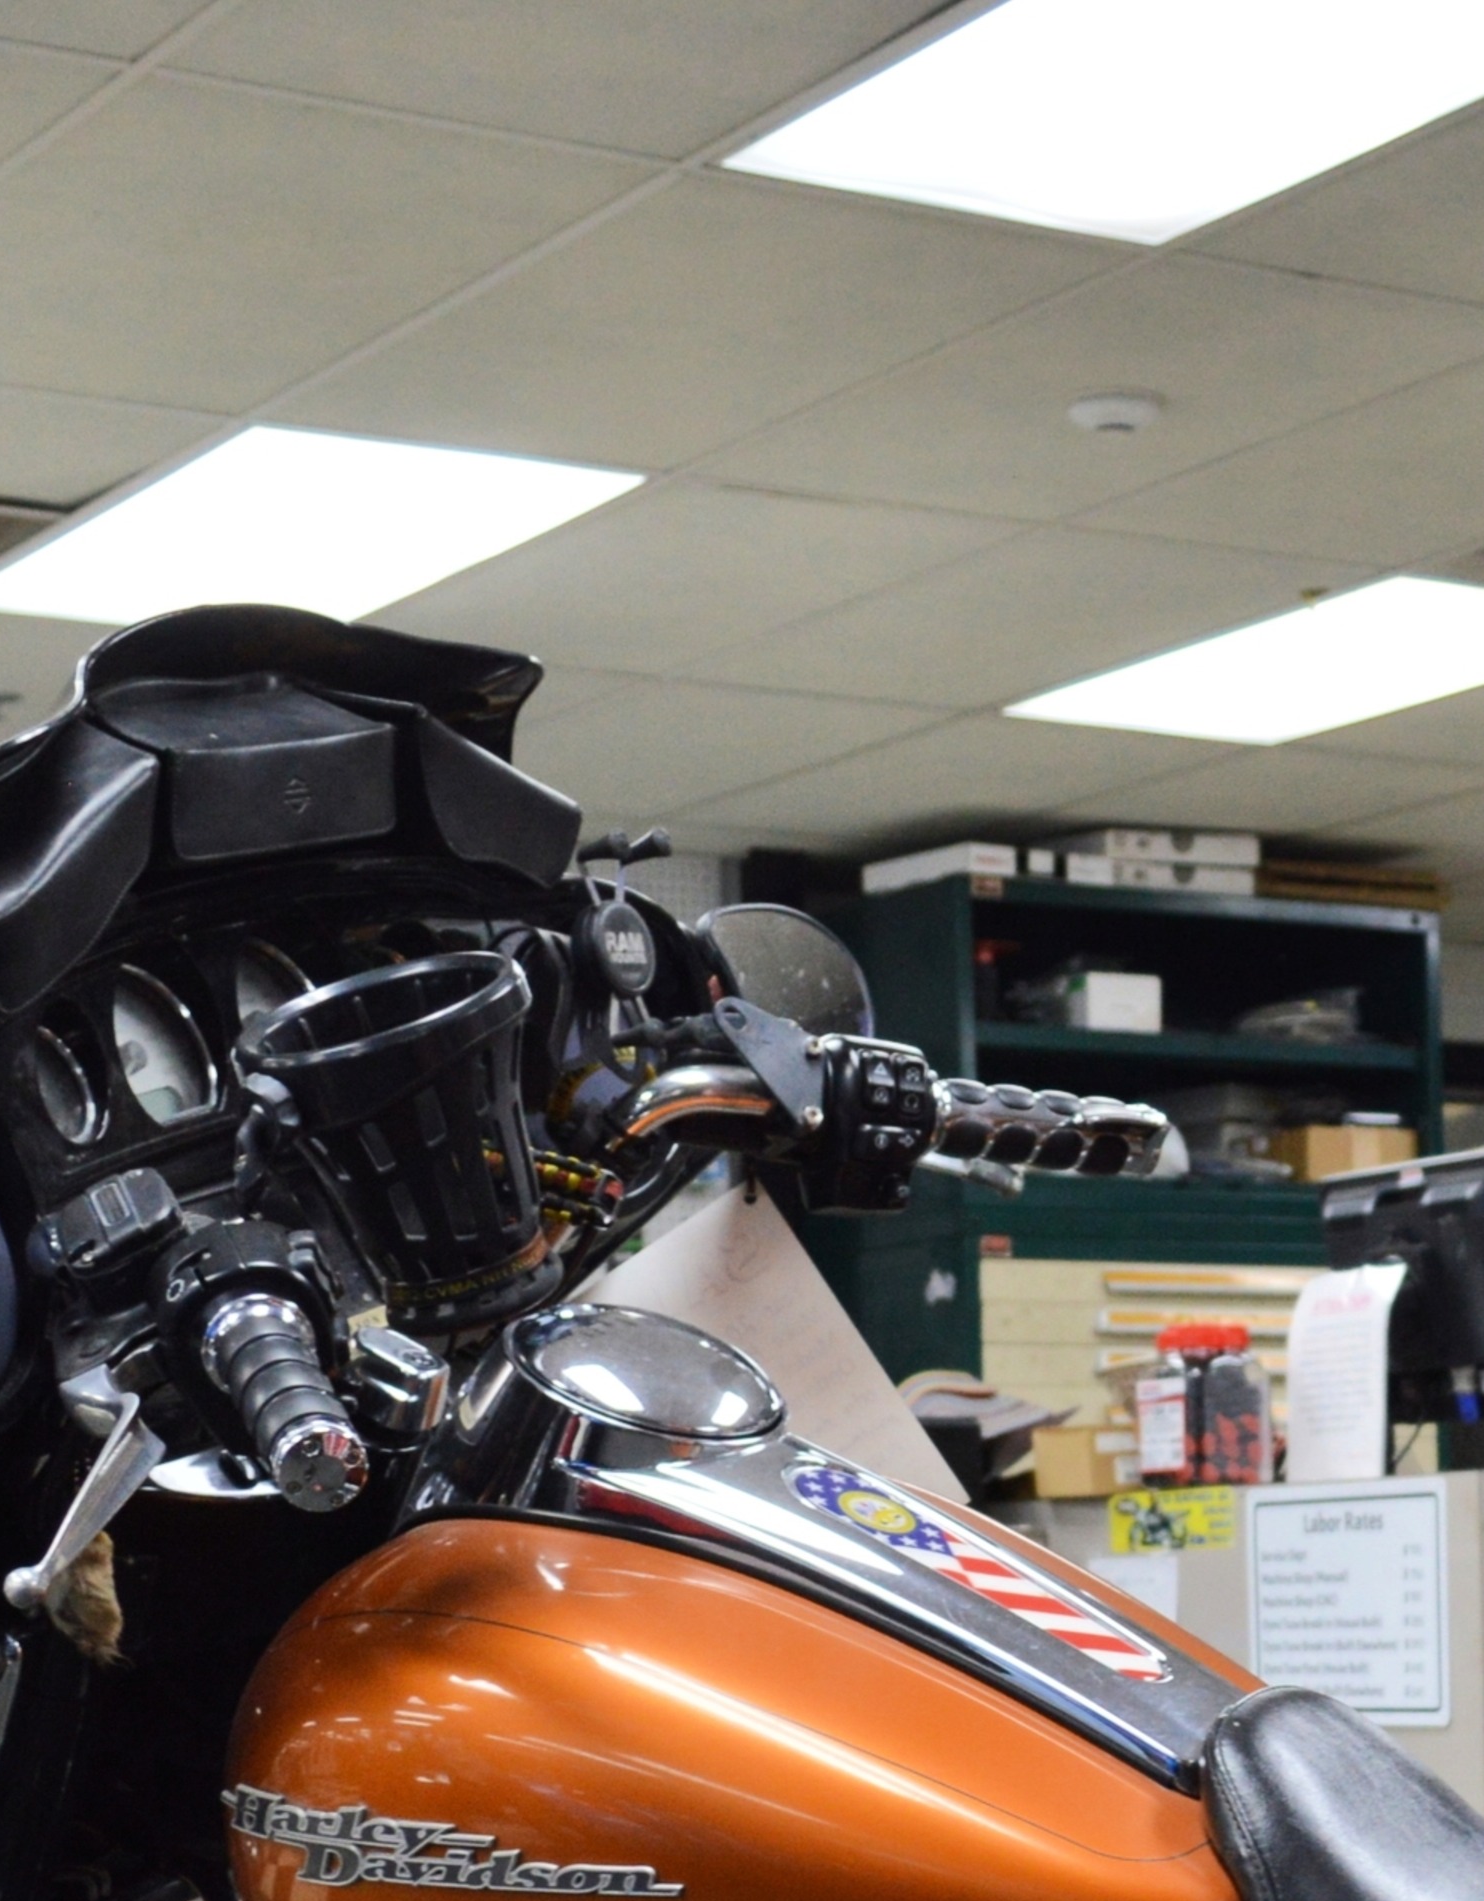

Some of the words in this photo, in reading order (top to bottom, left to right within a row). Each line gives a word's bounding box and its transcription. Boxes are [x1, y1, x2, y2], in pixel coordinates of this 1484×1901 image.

[1303, 1513, 1341, 1534] Labor
[1344, 1512, 1384, 1531] Rates
[297, 1841, 685, 1897] Davidson
